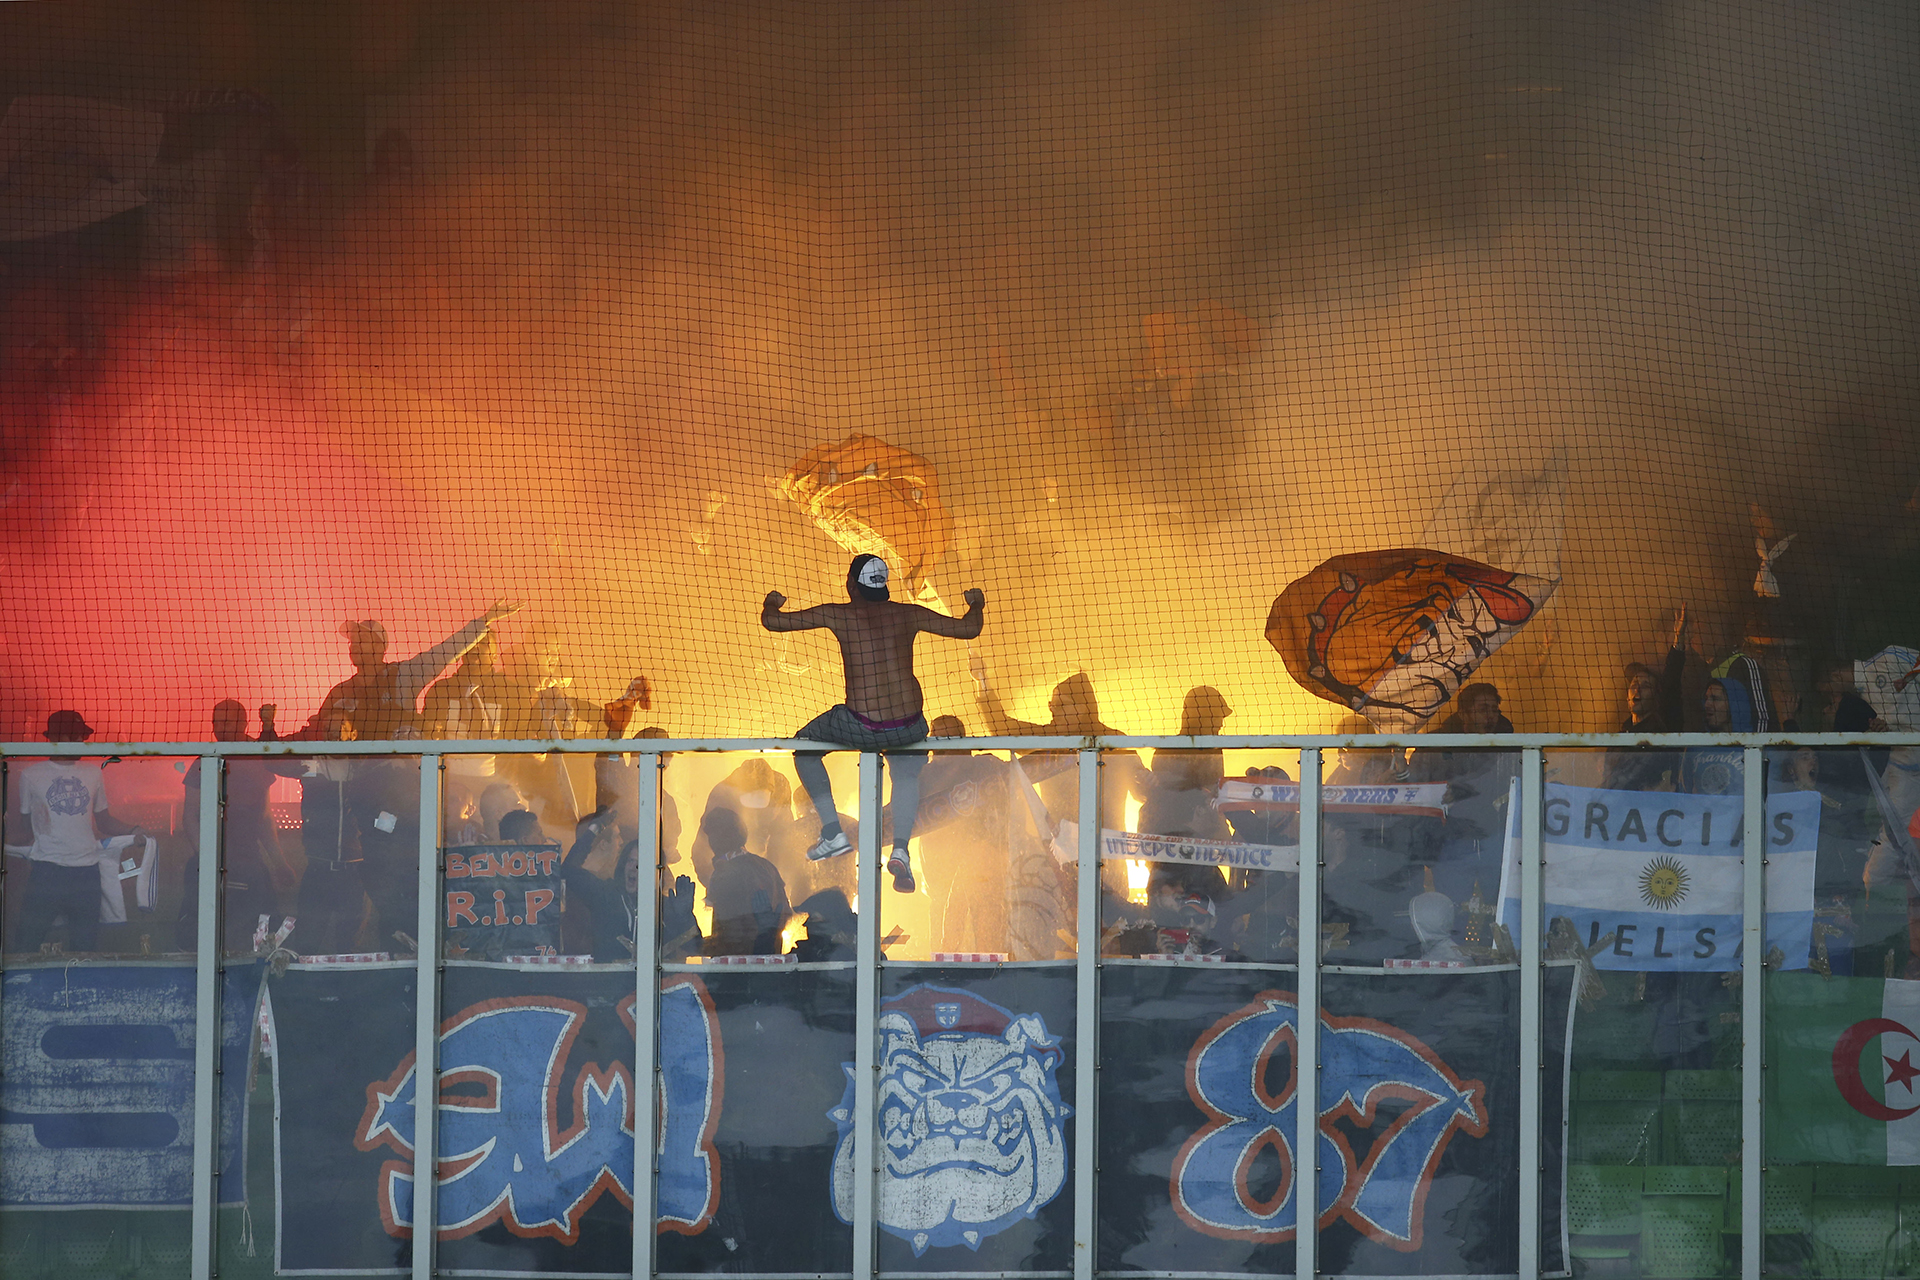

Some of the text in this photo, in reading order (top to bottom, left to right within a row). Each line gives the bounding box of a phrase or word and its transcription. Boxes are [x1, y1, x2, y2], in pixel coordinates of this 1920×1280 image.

[1271, 785, 1398, 803] WINERS
[1544, 799, 1795, 848] GRACIS
[1548, 916, 1744, 958] IELS
[1169, 990, 1489, 1252] 87
